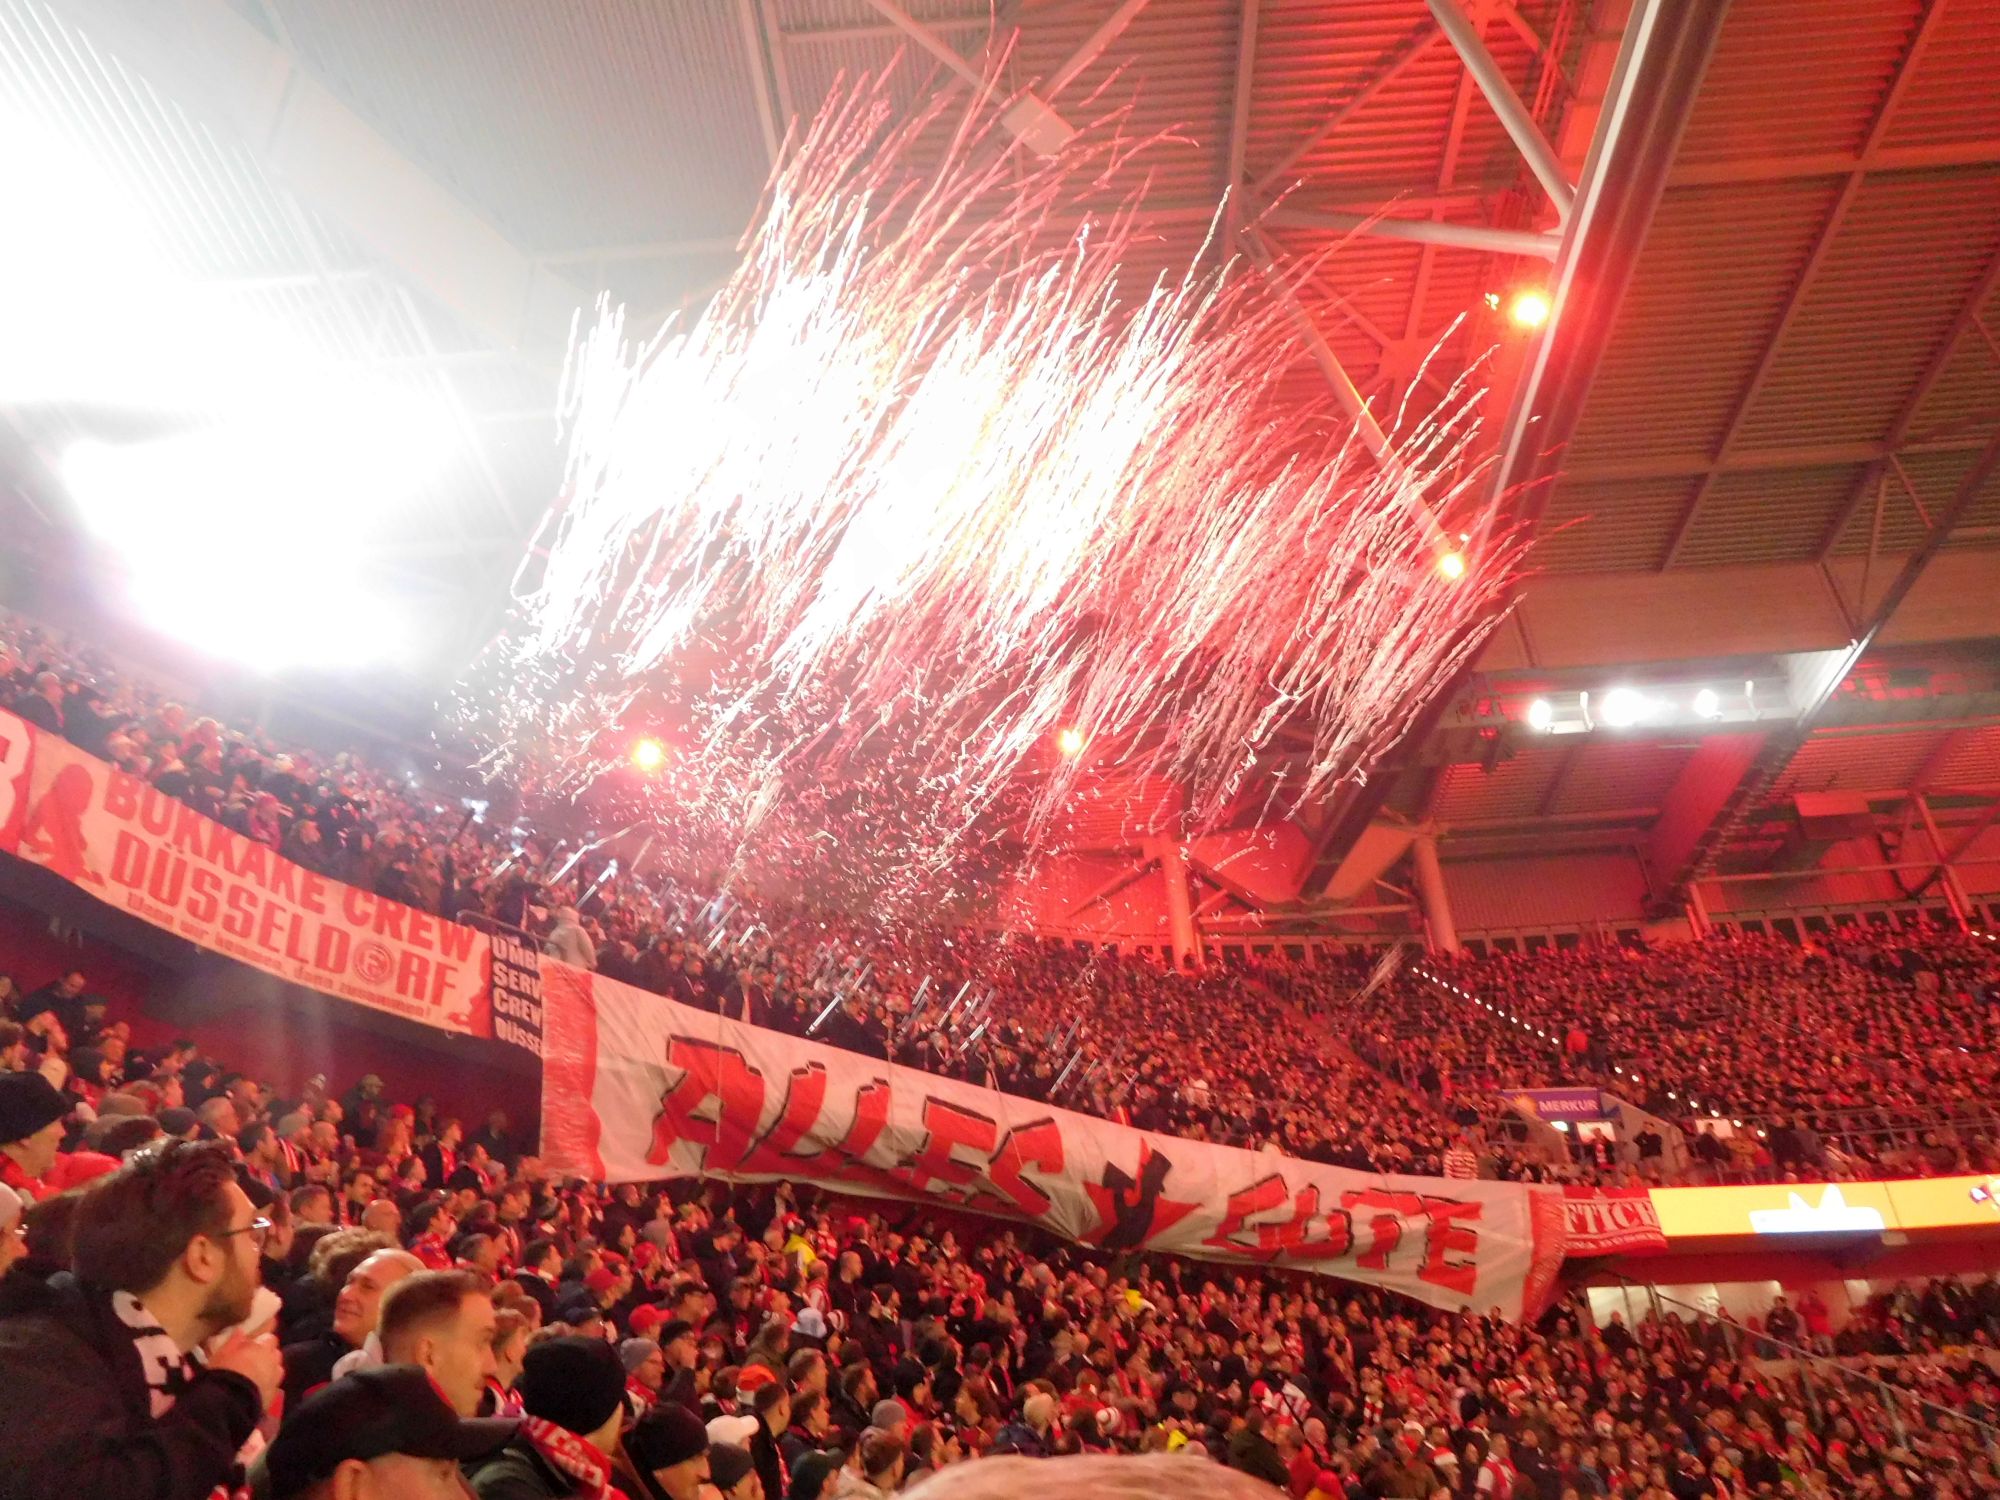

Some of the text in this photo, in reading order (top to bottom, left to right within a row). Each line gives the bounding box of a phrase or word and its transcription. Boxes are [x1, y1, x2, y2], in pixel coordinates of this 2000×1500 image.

[103, 770, 475, 963] BUKKAKE CREW
[1539, 1099, 1599, 1113] MERKUR
[1203, 1172, 1483, 1296] GUTE
